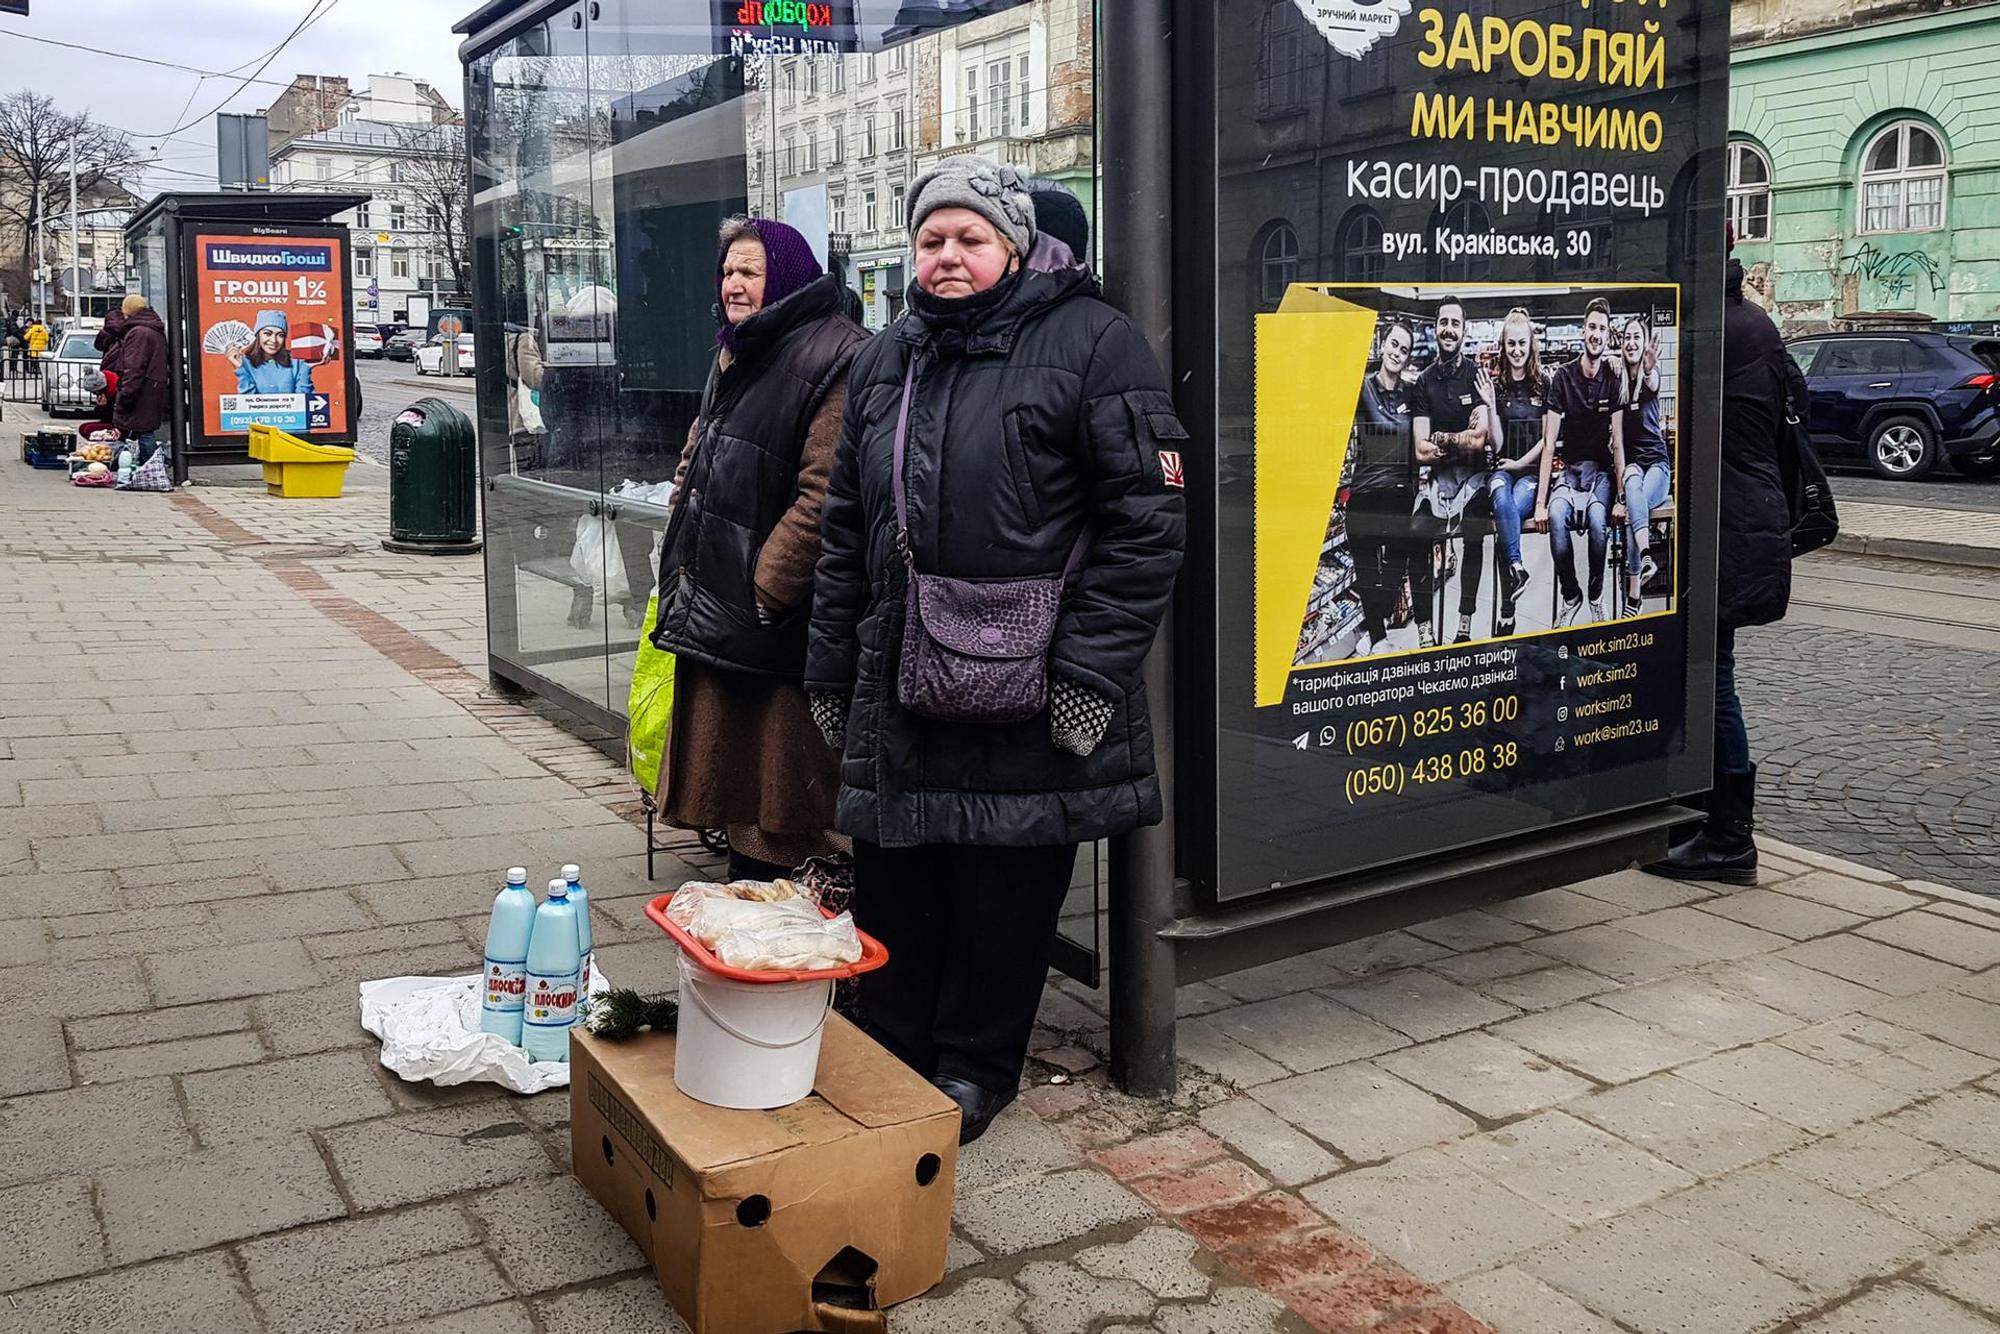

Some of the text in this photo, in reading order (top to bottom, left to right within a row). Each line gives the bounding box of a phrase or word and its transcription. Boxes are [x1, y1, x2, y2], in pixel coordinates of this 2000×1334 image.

[1317, 9, 1392, 24] ЗРУЧНИЙ МАРКЕТ
[1418, 8, 1665, 89] ЗАРОБЛЯЙ
[1411, 91, 1663, 152] МИ НАВЧИМО
[1347, 160, 1665, 217] касир-продавець
[212, 249, 326, 266] ШвидкоГроші
[1382, 228, 1592, 261] вул. Краківська, 30
[214, 276, 327, 299] ГРОШІ 1%
[215, 296, 288, 304] В РОЗСТРОЧКУ
[273, 415, 284, 424] 10
[312, 414, 326, 423] 50
[1577, 633, 1654, 657] work.sim23.ua
[1381, 660, 1430, 683] дзвінків
[1433, 654, 1471, 673] згідно
[1474, 647, 1517, 668] тарифу
[1576, 662, 1637, 688] work.sim23
[1293, 666, 1517, 715] вашого оператора Чекаємо дзвінка!
[1575, 693, 1632, 718] worksim23
[1346, 695, 1519, 755] (067) 825 36 00
[1573, 718, 1659, 747] work@sim23.ua
[1345, 742, 1518, 804] (050) 438 08 38
